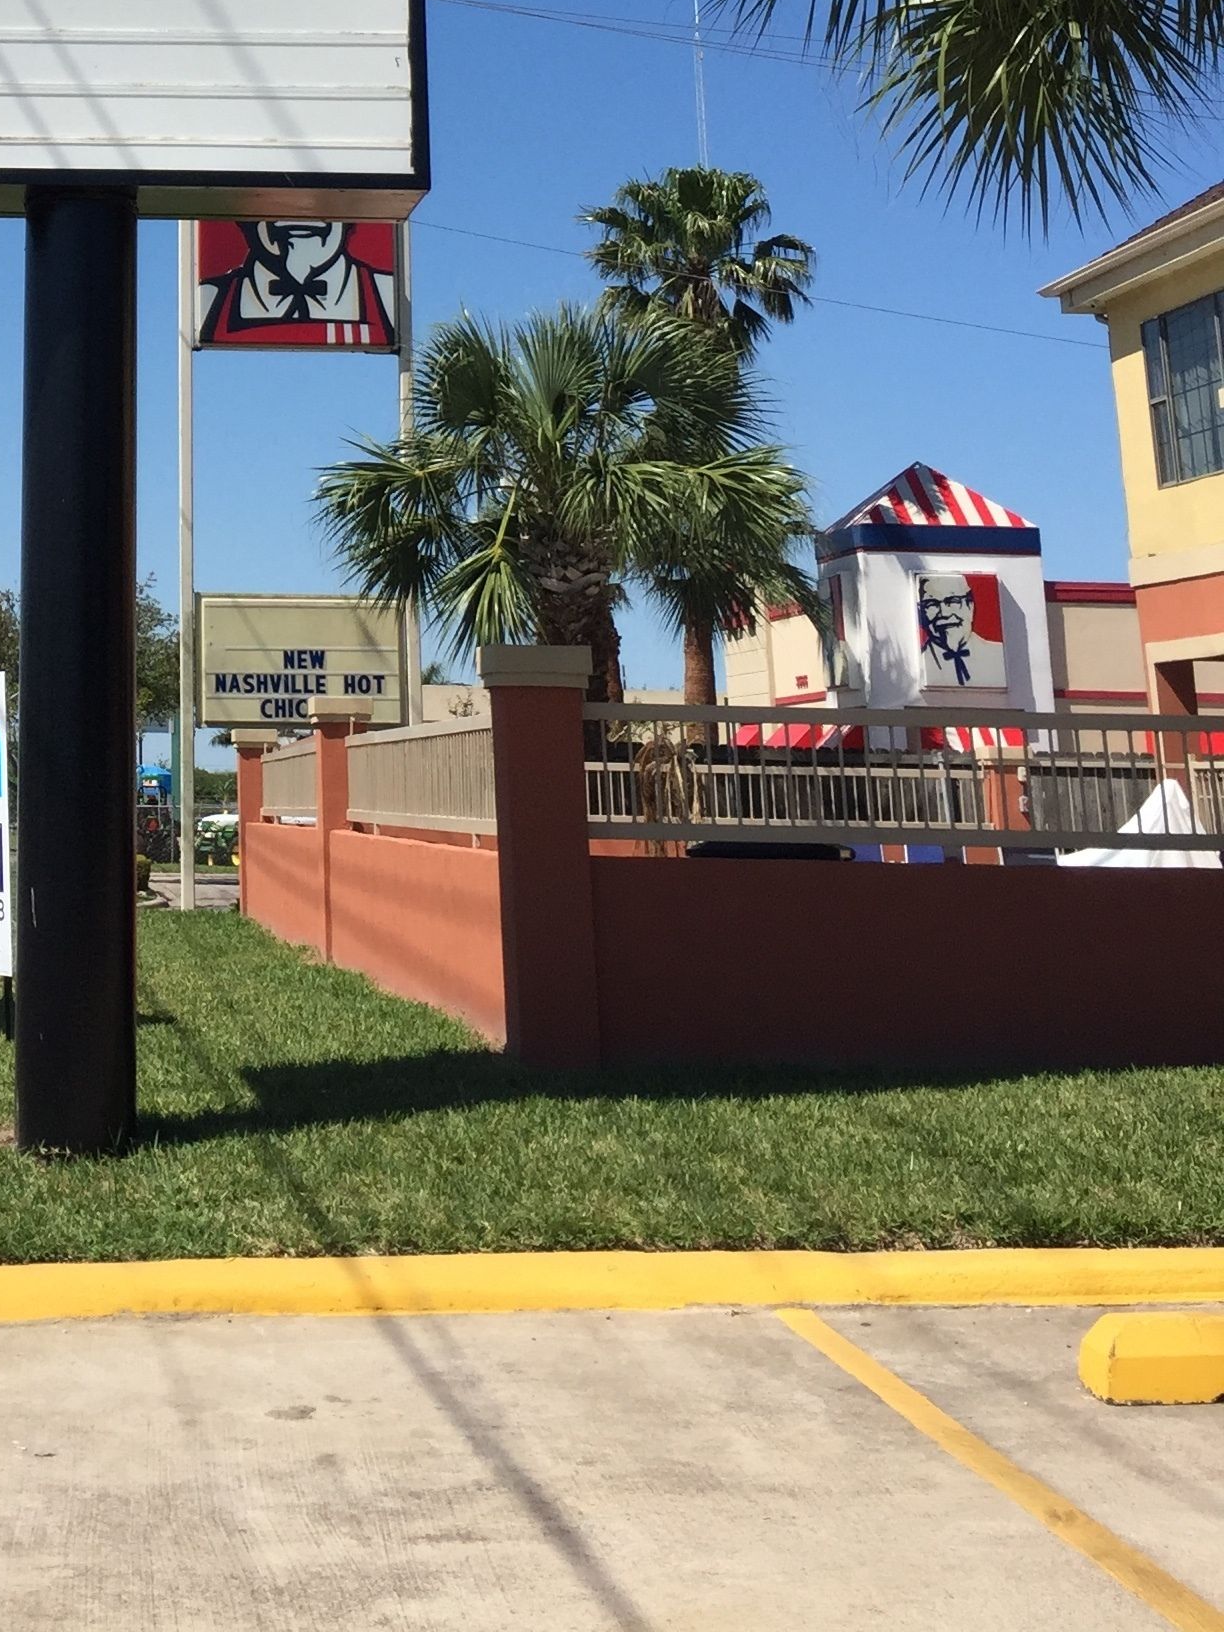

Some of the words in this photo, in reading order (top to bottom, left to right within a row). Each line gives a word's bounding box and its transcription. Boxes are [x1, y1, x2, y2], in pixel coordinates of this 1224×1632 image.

[283, 650, 326, 669] NEW
[215, 673, 326, 694] NASHVILLE
[344, 674, 385, 694] HOT
[260, 698, 309, 719] CHIC
